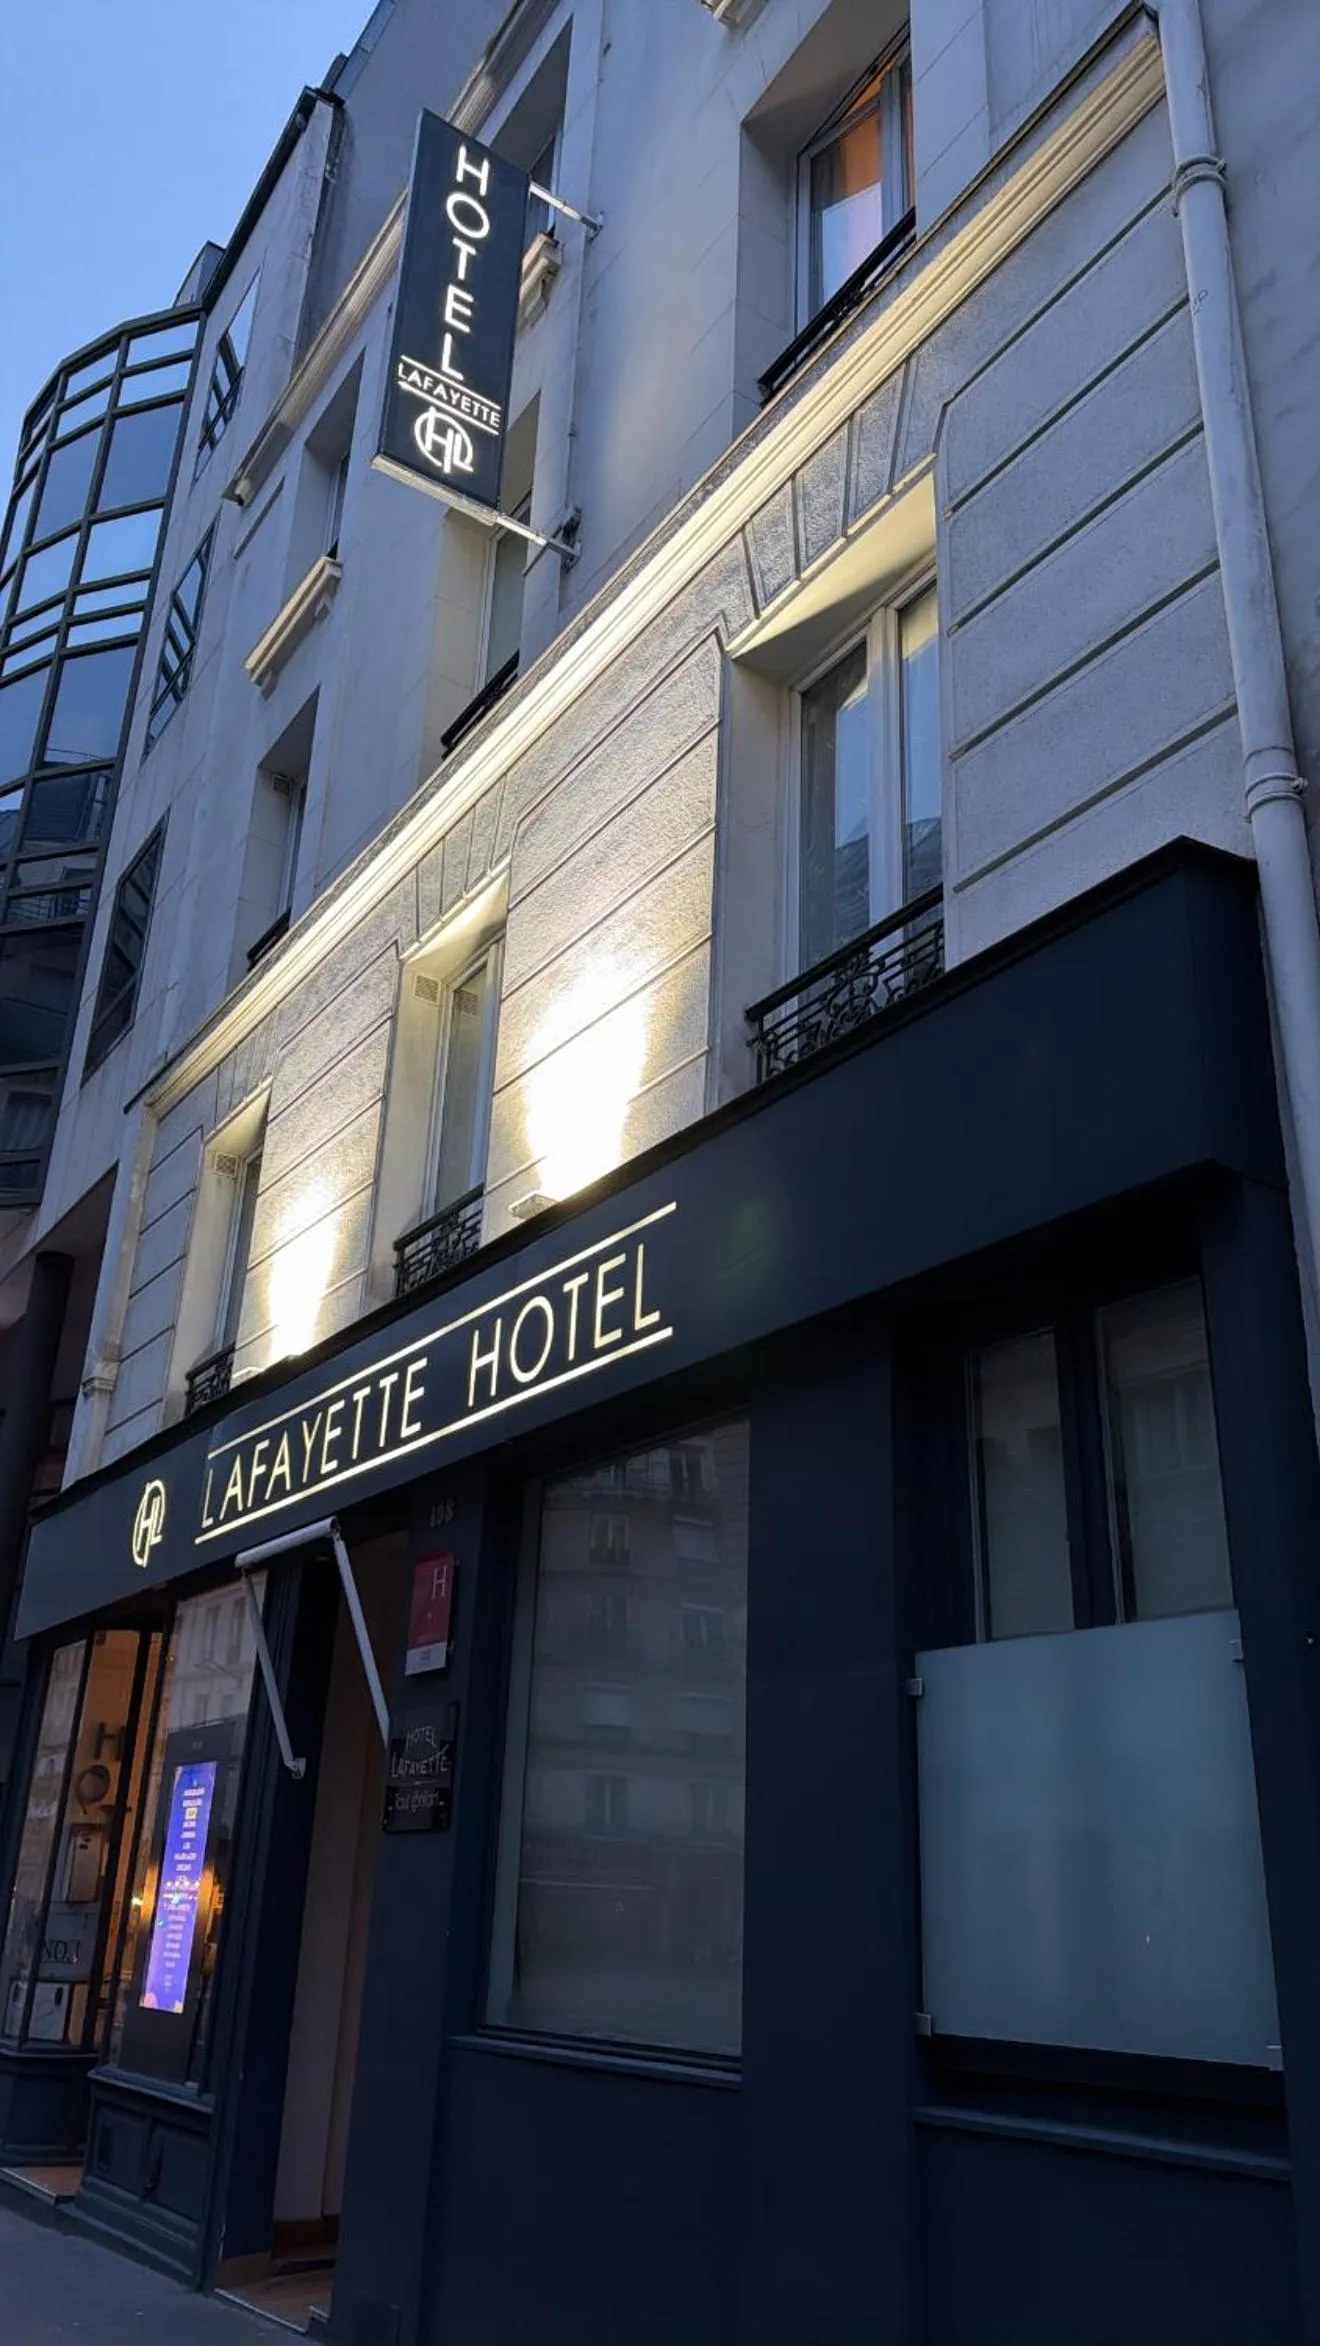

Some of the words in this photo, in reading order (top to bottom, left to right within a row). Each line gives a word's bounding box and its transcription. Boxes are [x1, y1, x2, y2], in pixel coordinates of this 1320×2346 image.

[440, 142, 491, 382] HOTEL
[398, 361, 501, 427] LAFAYETTE
[201, 1357, 428, 1529] LAFAYETTE
[467, 1243, 661, 1408] HOTEL
[430, 1565, 447, 1600] H
